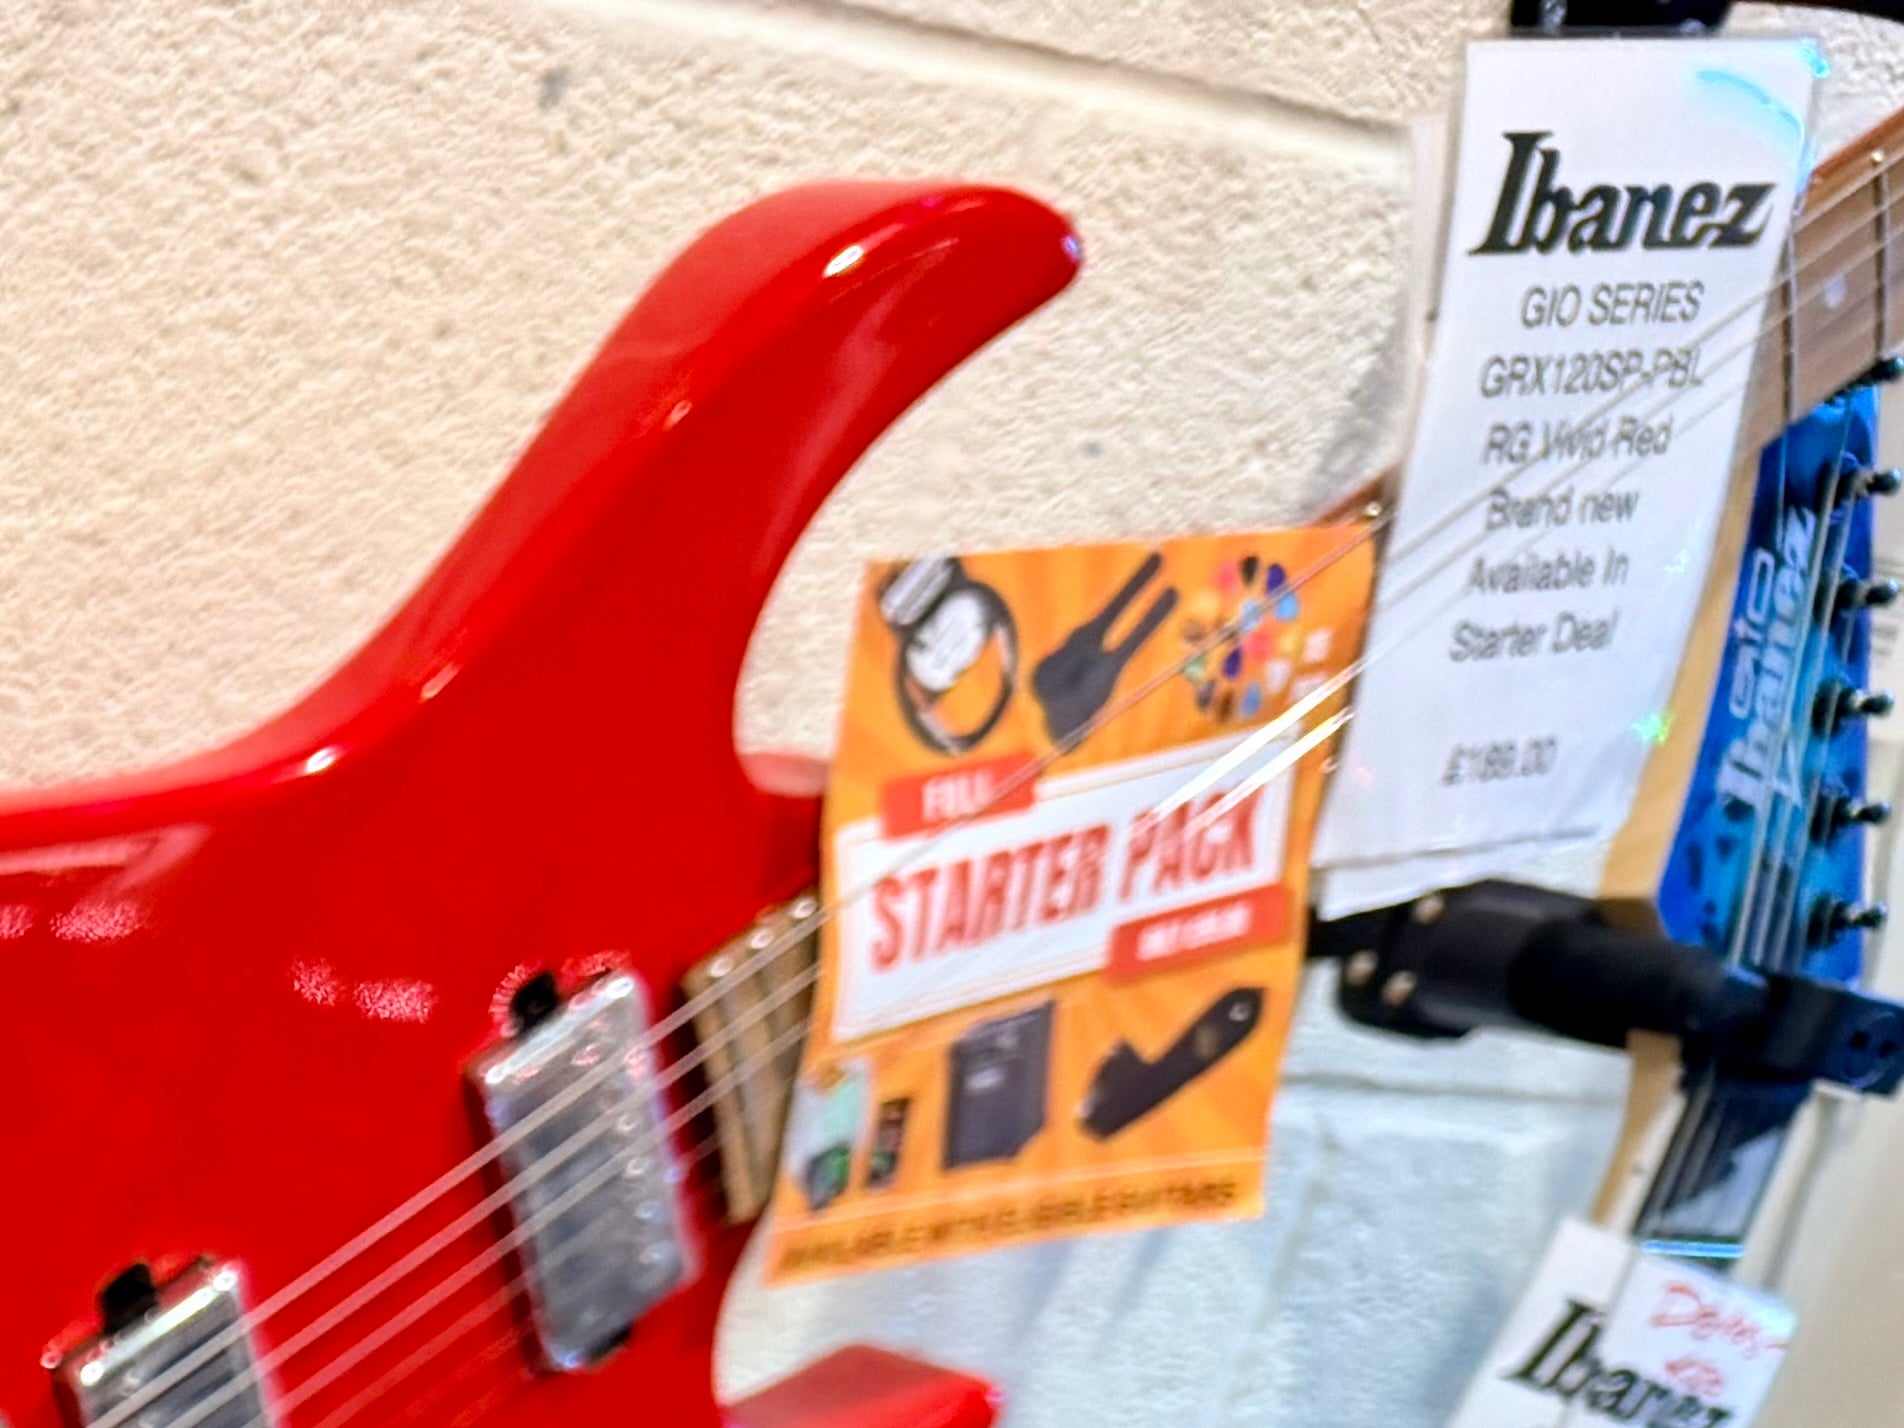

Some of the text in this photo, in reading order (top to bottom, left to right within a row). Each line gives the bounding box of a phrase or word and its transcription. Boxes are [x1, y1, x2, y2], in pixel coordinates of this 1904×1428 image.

[1469, 131, 1777, 256] Ibanez
[1520, 280, 1703, 330] GIO SERIES
[1614, 412, 1674, 459] Red
[1485, 486, 1639, 531] Brand new
[1466, 552, 1630, 594] Available In
[1449, 612, 1621, 664] Starter Deal
[871, 824, 1110, 974] STARTER
[1118, 784, 1266, 903] PACK
